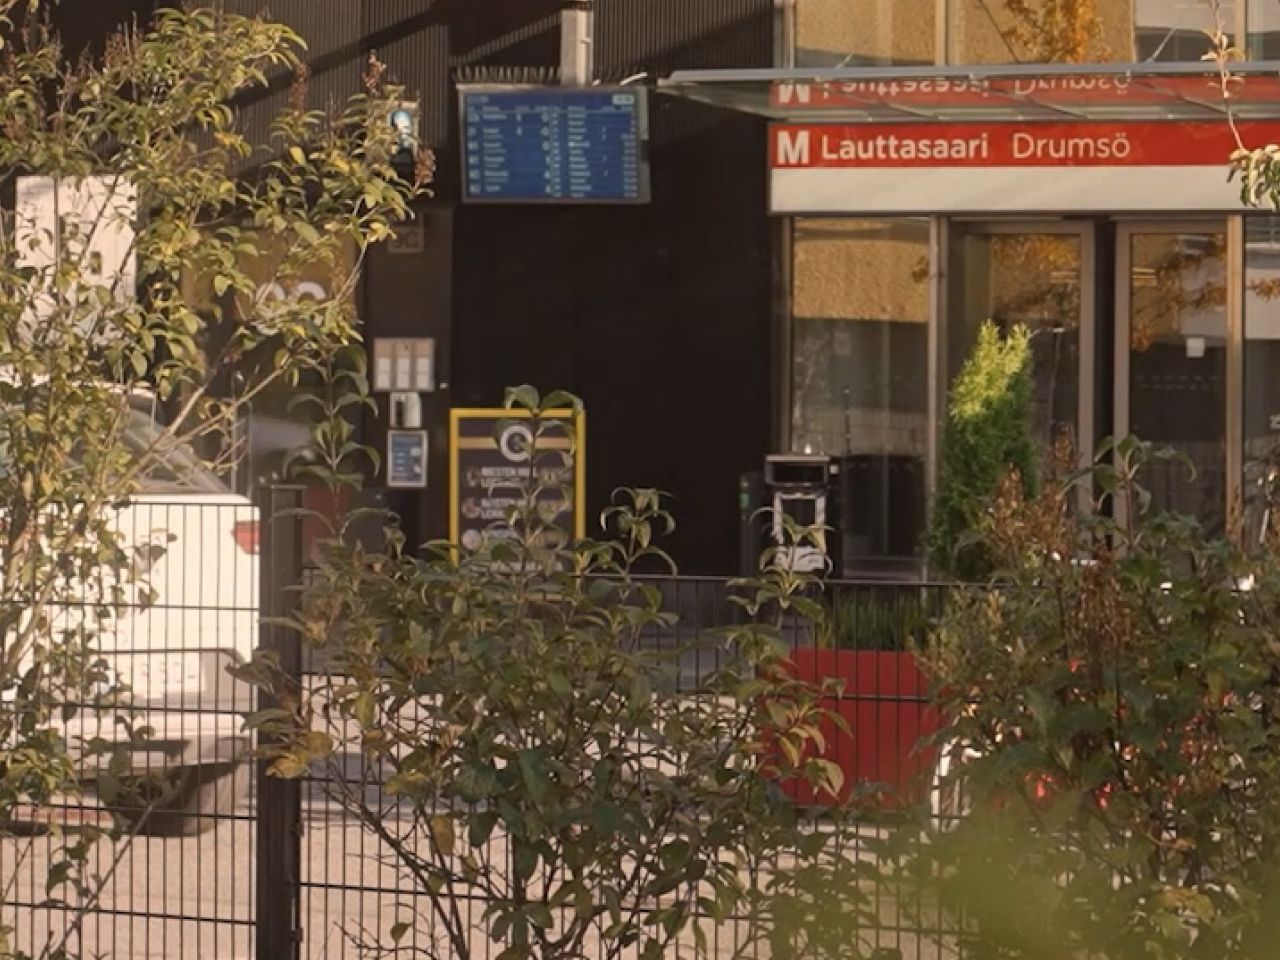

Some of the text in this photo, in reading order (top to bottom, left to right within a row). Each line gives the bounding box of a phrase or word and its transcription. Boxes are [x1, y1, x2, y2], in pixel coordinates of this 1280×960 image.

[776, 130, 1131, 165] M Lauttasaari Drumsö
